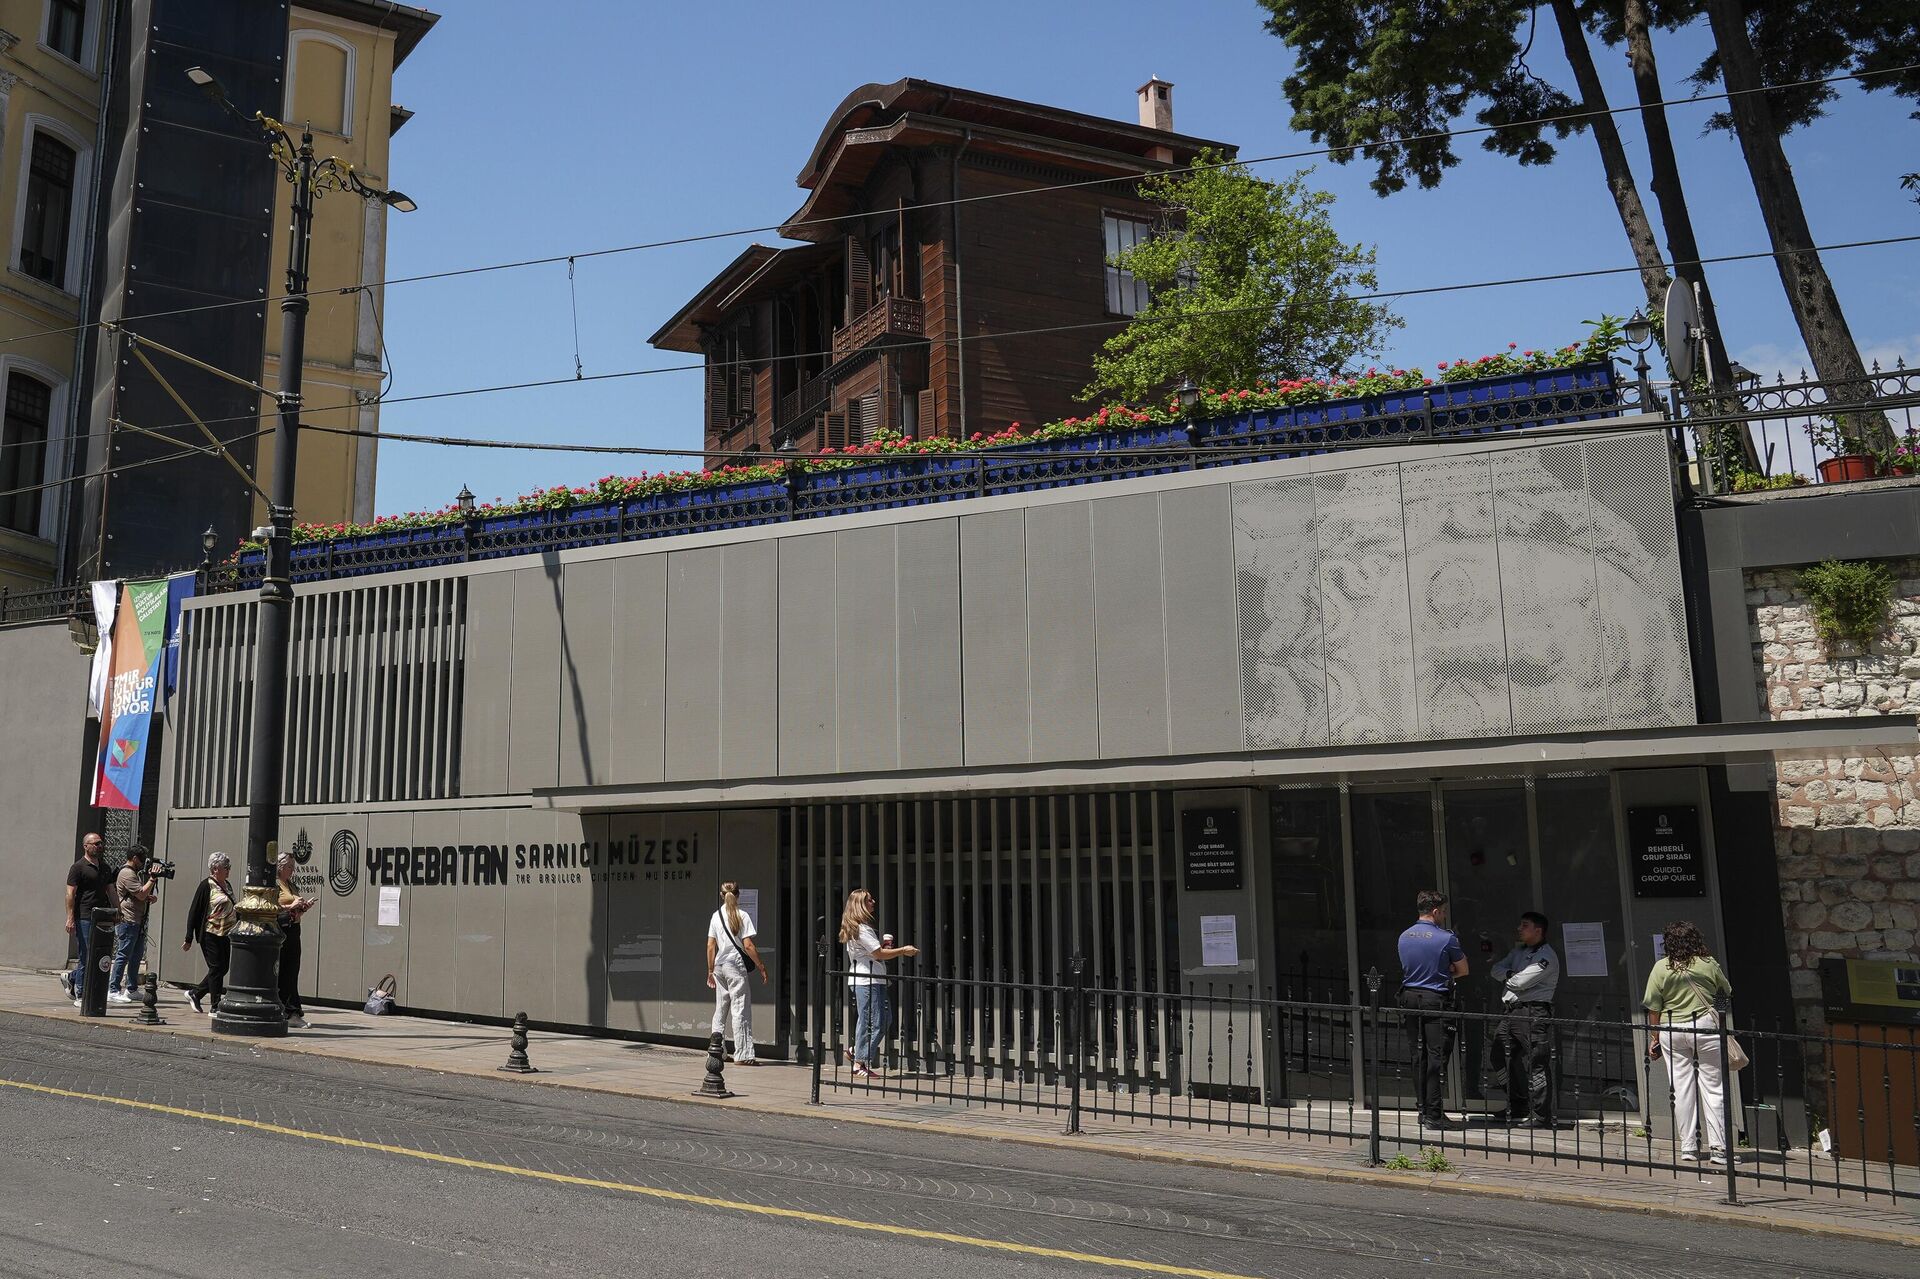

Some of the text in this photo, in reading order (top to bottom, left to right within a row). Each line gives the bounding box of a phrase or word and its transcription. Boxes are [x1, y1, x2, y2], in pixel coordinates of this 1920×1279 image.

[1647, 844, 1684, 853] REHBERLİ
[366, 832, 698, 886] YEREBATAN SARNICI MÜZESİ
[1653, 866, 1683, 874] GUIDED
[515, 873, 532, 884] THE
[539, 873, 582, 884] BASILICA
[591, 871, 636, 882] CISTERN
[1670, 874, 1697, 882] QUEUE
